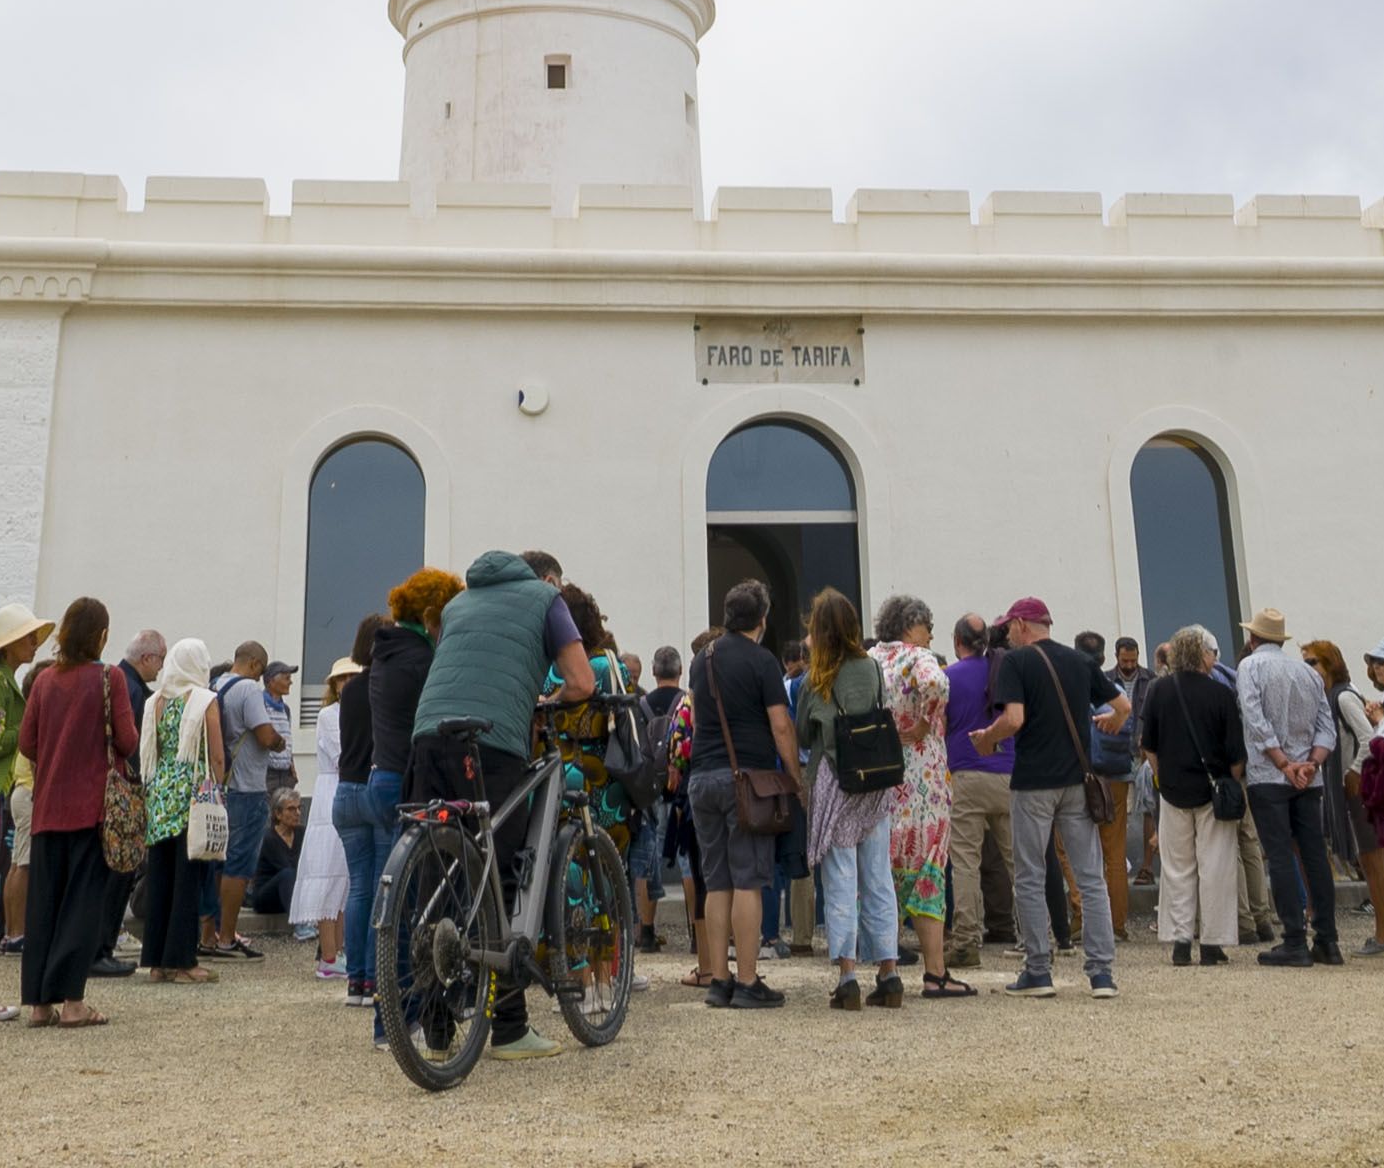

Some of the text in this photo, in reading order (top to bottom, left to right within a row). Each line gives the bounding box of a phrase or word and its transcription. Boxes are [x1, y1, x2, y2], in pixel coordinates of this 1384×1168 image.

[707, 345, 851, 367] FARO DE TARIFA
